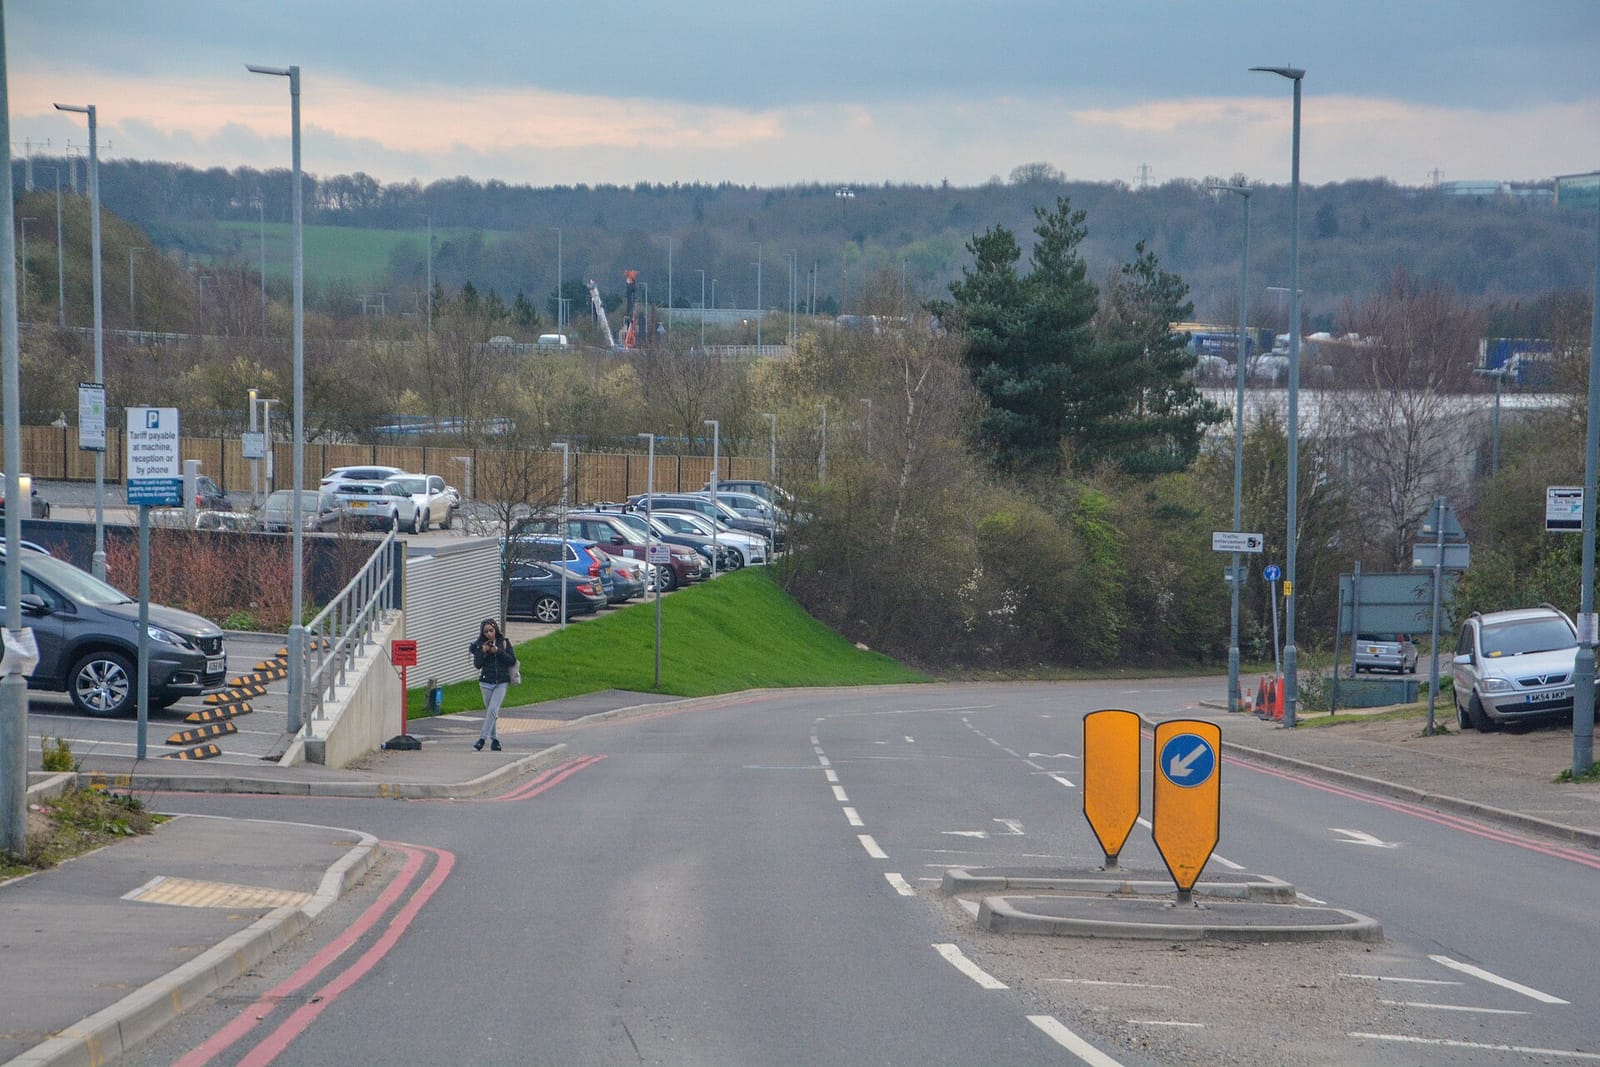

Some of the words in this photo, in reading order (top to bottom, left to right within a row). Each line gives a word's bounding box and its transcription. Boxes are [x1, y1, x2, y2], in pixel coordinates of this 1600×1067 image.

[148, 411, 158, 428] P
[129, 431, 147, 440] Tariff
[148, 431, 176, 442] payable
[141, 443, 173, 453] machine,
[131, 455, 164, 465] reception
[136, 466, 145, 475] by
[146, 466, 169, 475] phone
[1532, 693, 1549, 701] AK54
[1551, 691, 1565, 699] AKP
